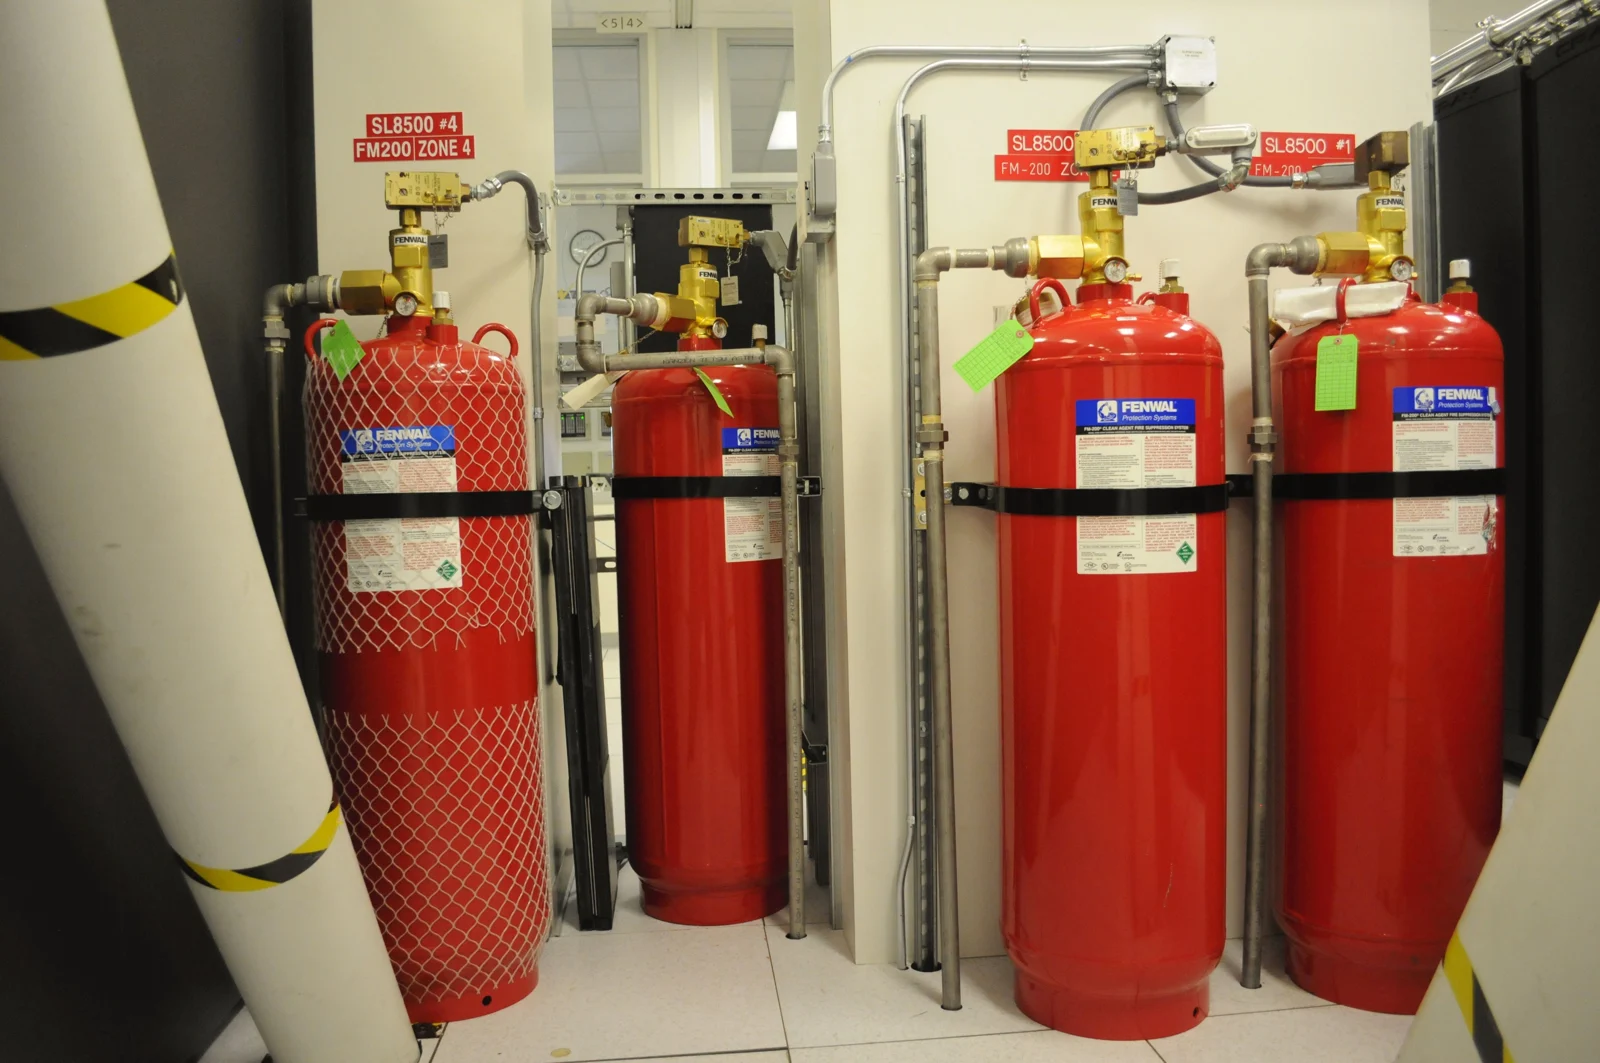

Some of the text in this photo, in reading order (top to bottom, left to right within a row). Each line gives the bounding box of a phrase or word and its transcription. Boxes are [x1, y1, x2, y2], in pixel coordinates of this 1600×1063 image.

[371, 114, 458, 134] SL8500 #4
[356, 138, 471, 158] FM200 ZONE 4
[1012, 134, 1074, 152] SL8500
[1265, 137, 1350, 154] SL8500 #1
[1001, 162, 1051, 176] FM-200
[394, 236, 426, 244] FENWAL
[1438, 388, 1484, 400] FENWAL
[1121, 401, 1178, 413] FENWAL
[376, 428, 432, 441] FENWAL
[754, 430, 780, 439] FENWA
